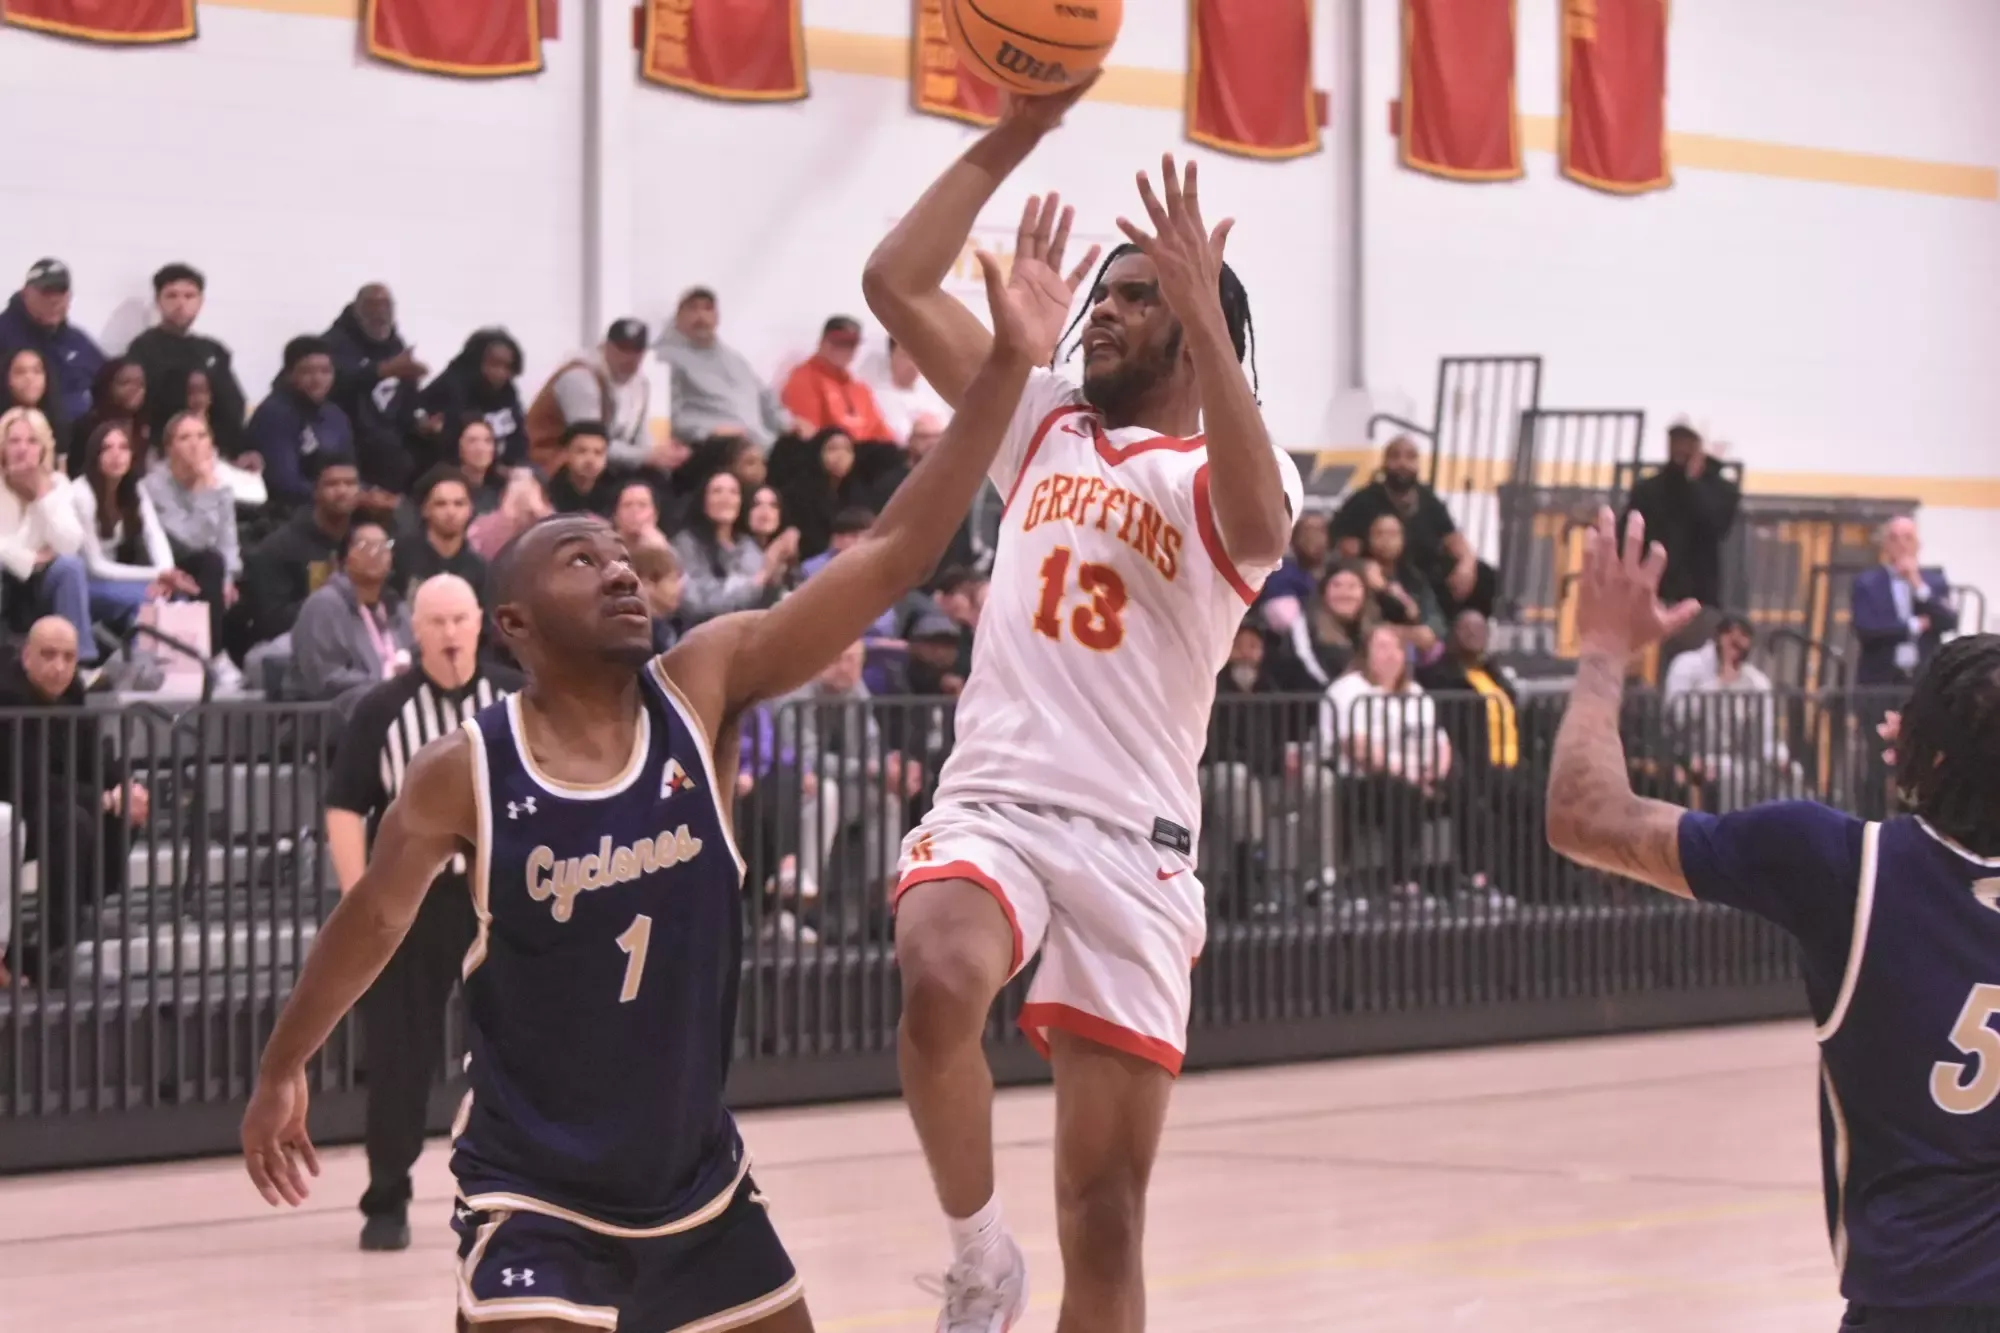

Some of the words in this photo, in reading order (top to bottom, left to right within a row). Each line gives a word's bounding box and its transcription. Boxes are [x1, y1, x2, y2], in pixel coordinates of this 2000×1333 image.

[1023, 473, 1183, 582] GRIFFINS
[1033, 545, 1127, 652] 13
[526, 824, 702, 923] Cyclones
[615, 914, 652, 1003] 1
[1929, 982, 2000, 1115] 5
